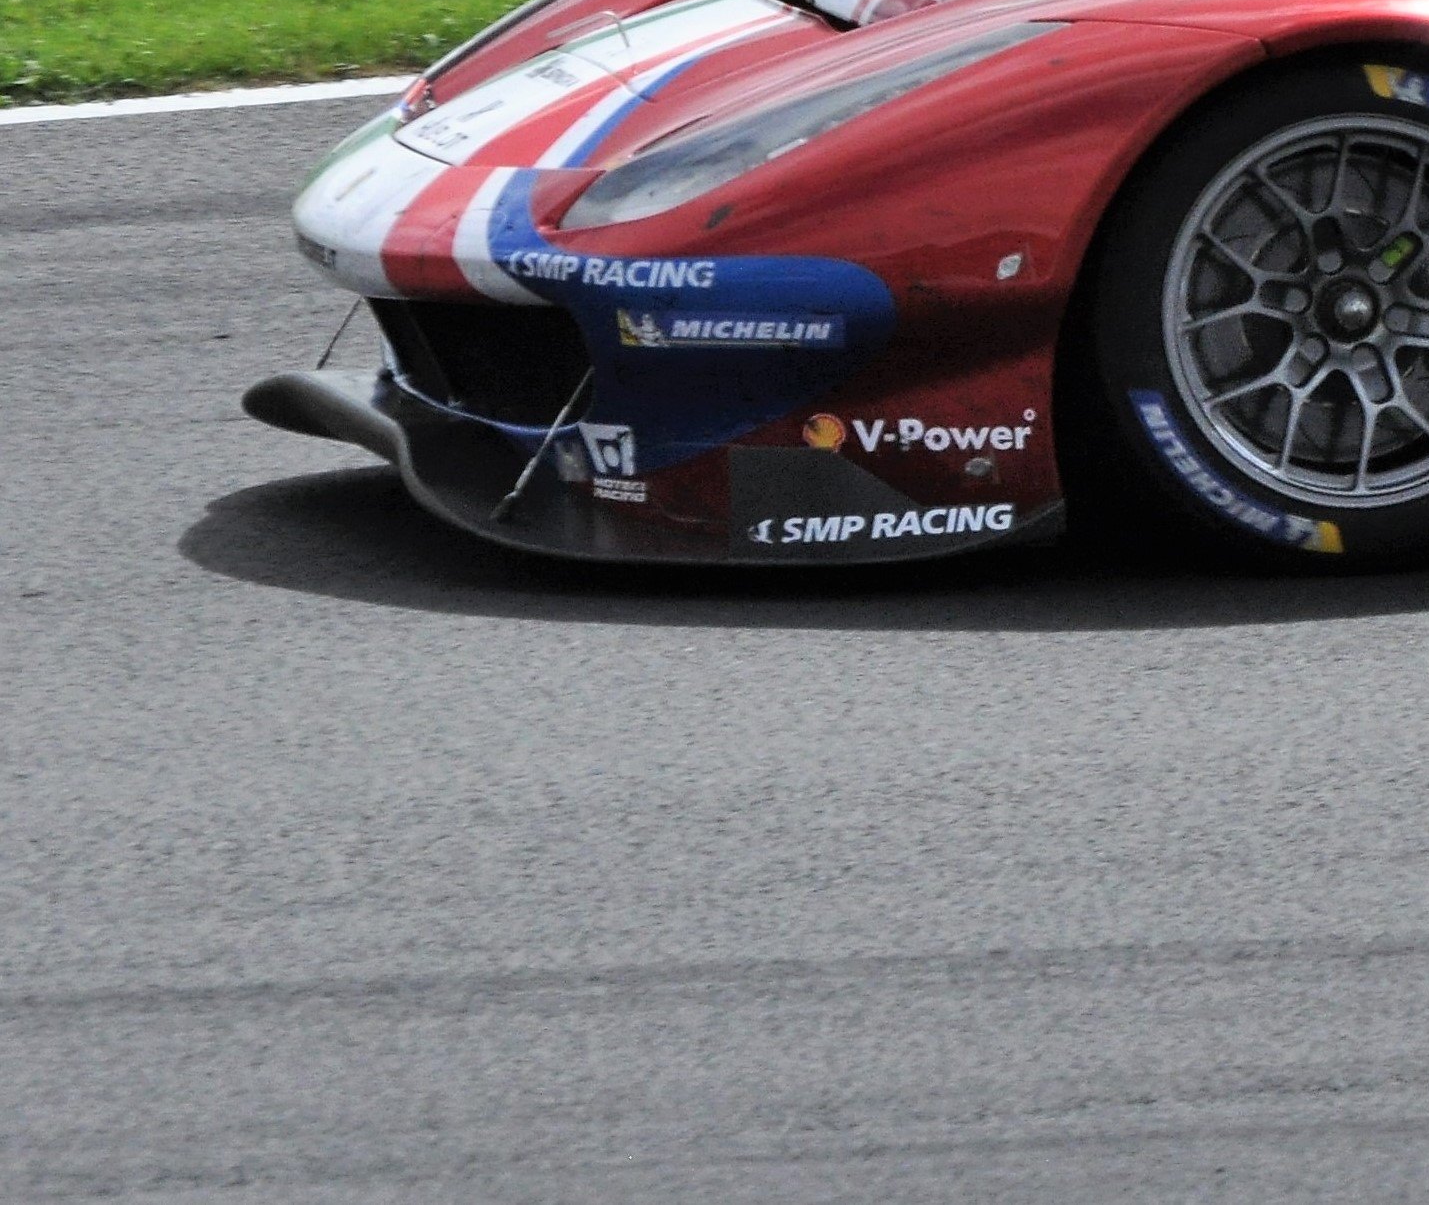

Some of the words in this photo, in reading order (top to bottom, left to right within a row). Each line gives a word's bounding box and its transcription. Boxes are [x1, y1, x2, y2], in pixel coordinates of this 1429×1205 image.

[522, 250, 580, 282] SMP
[582, 259, 717, 289] RACING
[670, 319, 832, 341] MICHELIN
[852, 416, 1032, 453] V-Power
[1138, 402, 1280, 533] MICHELIN
[780, 513, 867, 544] SMP
[871, 503, 1015, 540] RACING
